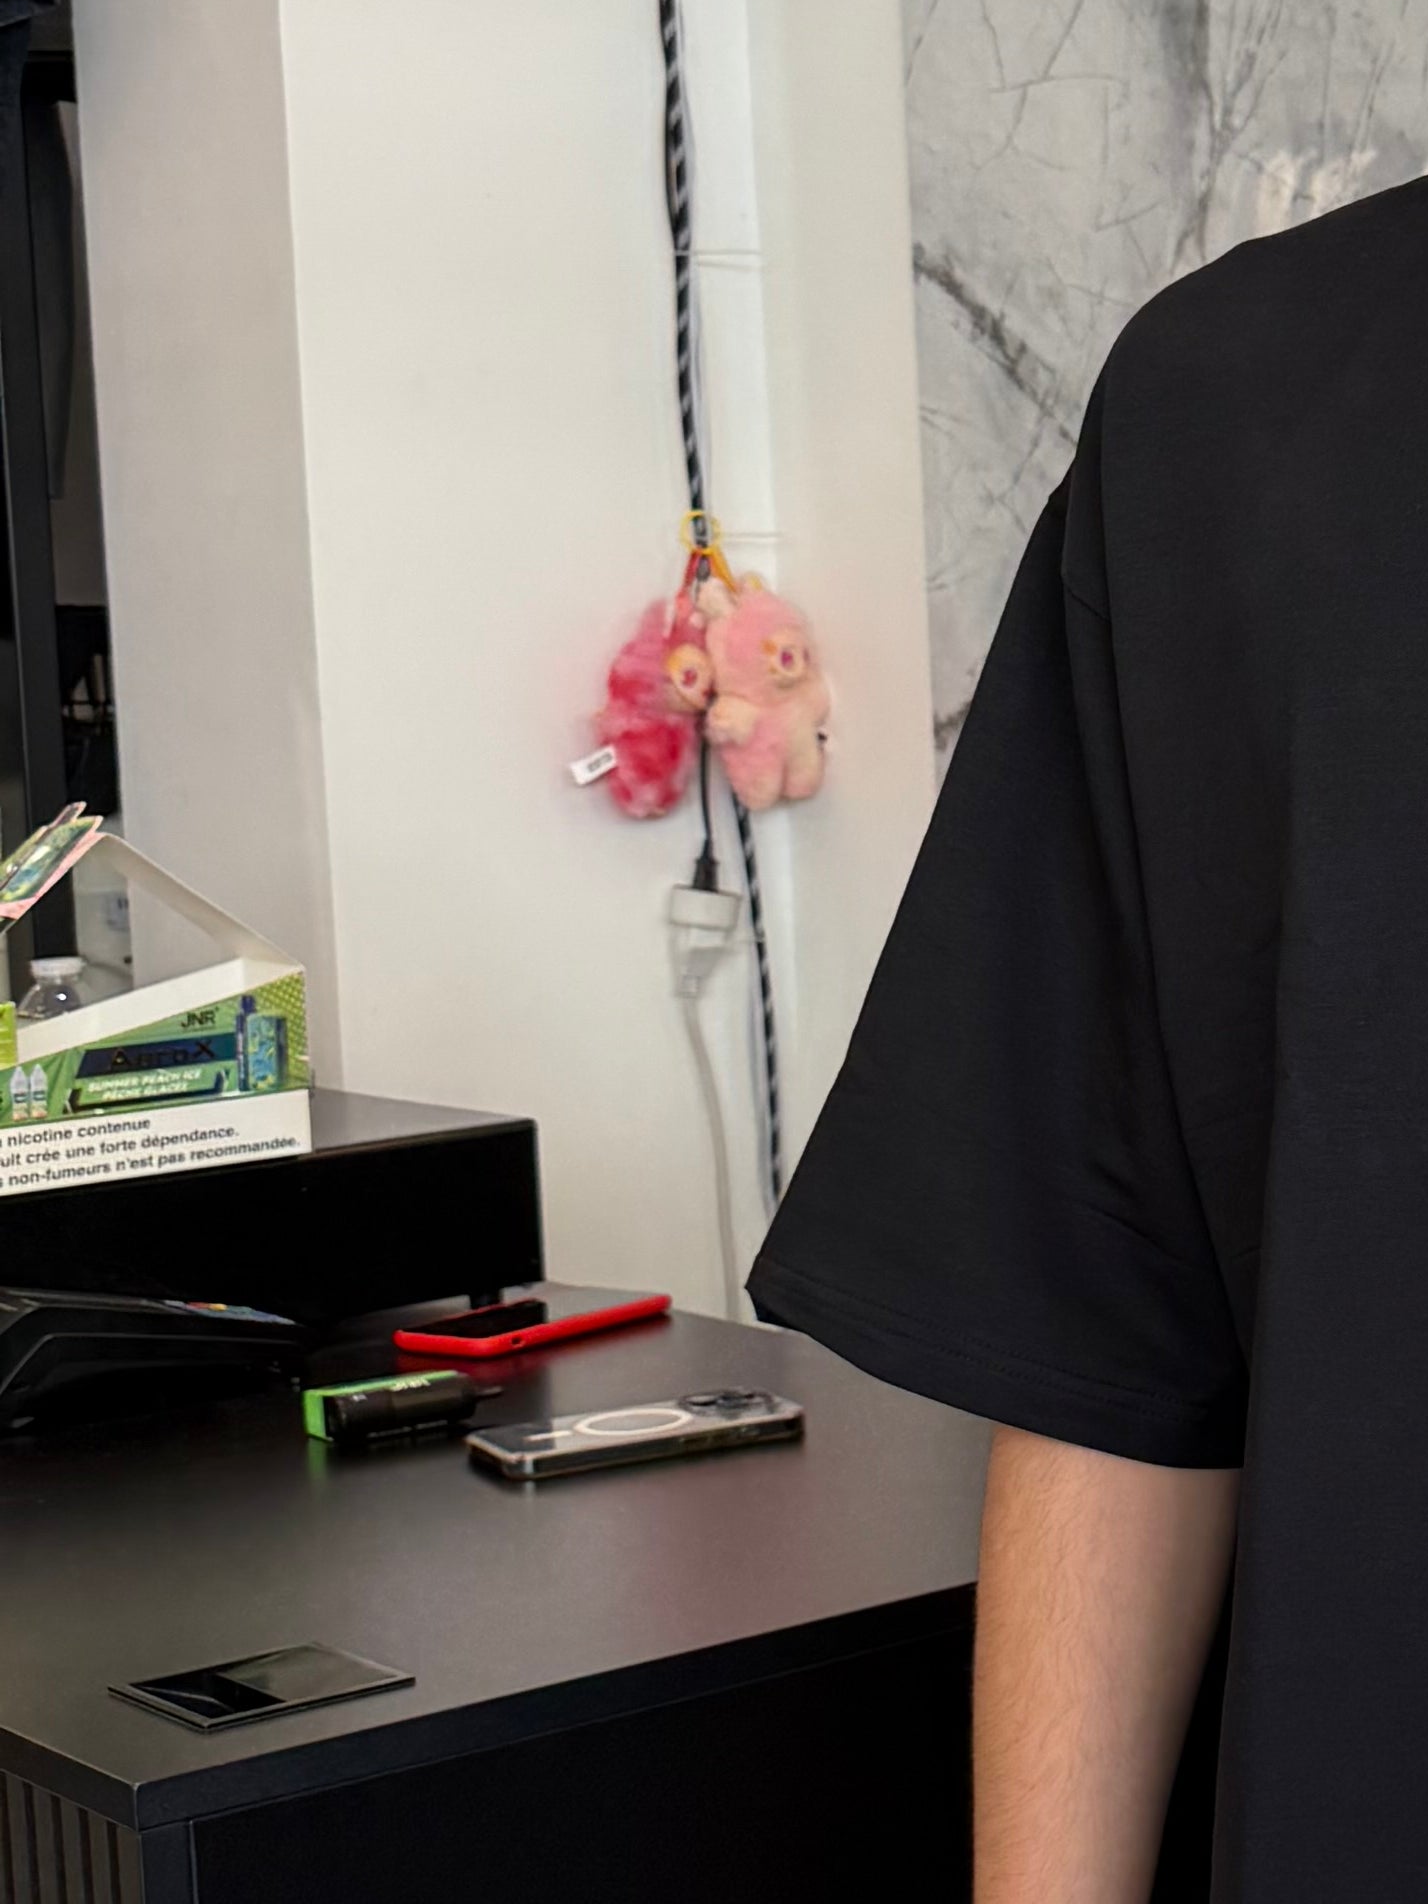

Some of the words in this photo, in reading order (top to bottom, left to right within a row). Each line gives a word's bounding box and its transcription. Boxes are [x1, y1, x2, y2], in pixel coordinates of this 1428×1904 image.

[7, 1129, 73, 1147] nicotine
[77, 1118, 150, 1141] contenue
[26, 1148, 60, 1164] crée
[66, 1145, 95, 1159] une
[100, 1137, 136, 1155] forte
[141, 1125, 240, 1151] dépendance.
[9, 1162, 111, 1186] non-fumeurs
[116, 1154, 153, 1172] n'est
[158, 1153, 186, 1169] pas
[190, 1136, 301, 1162] recommandée.
